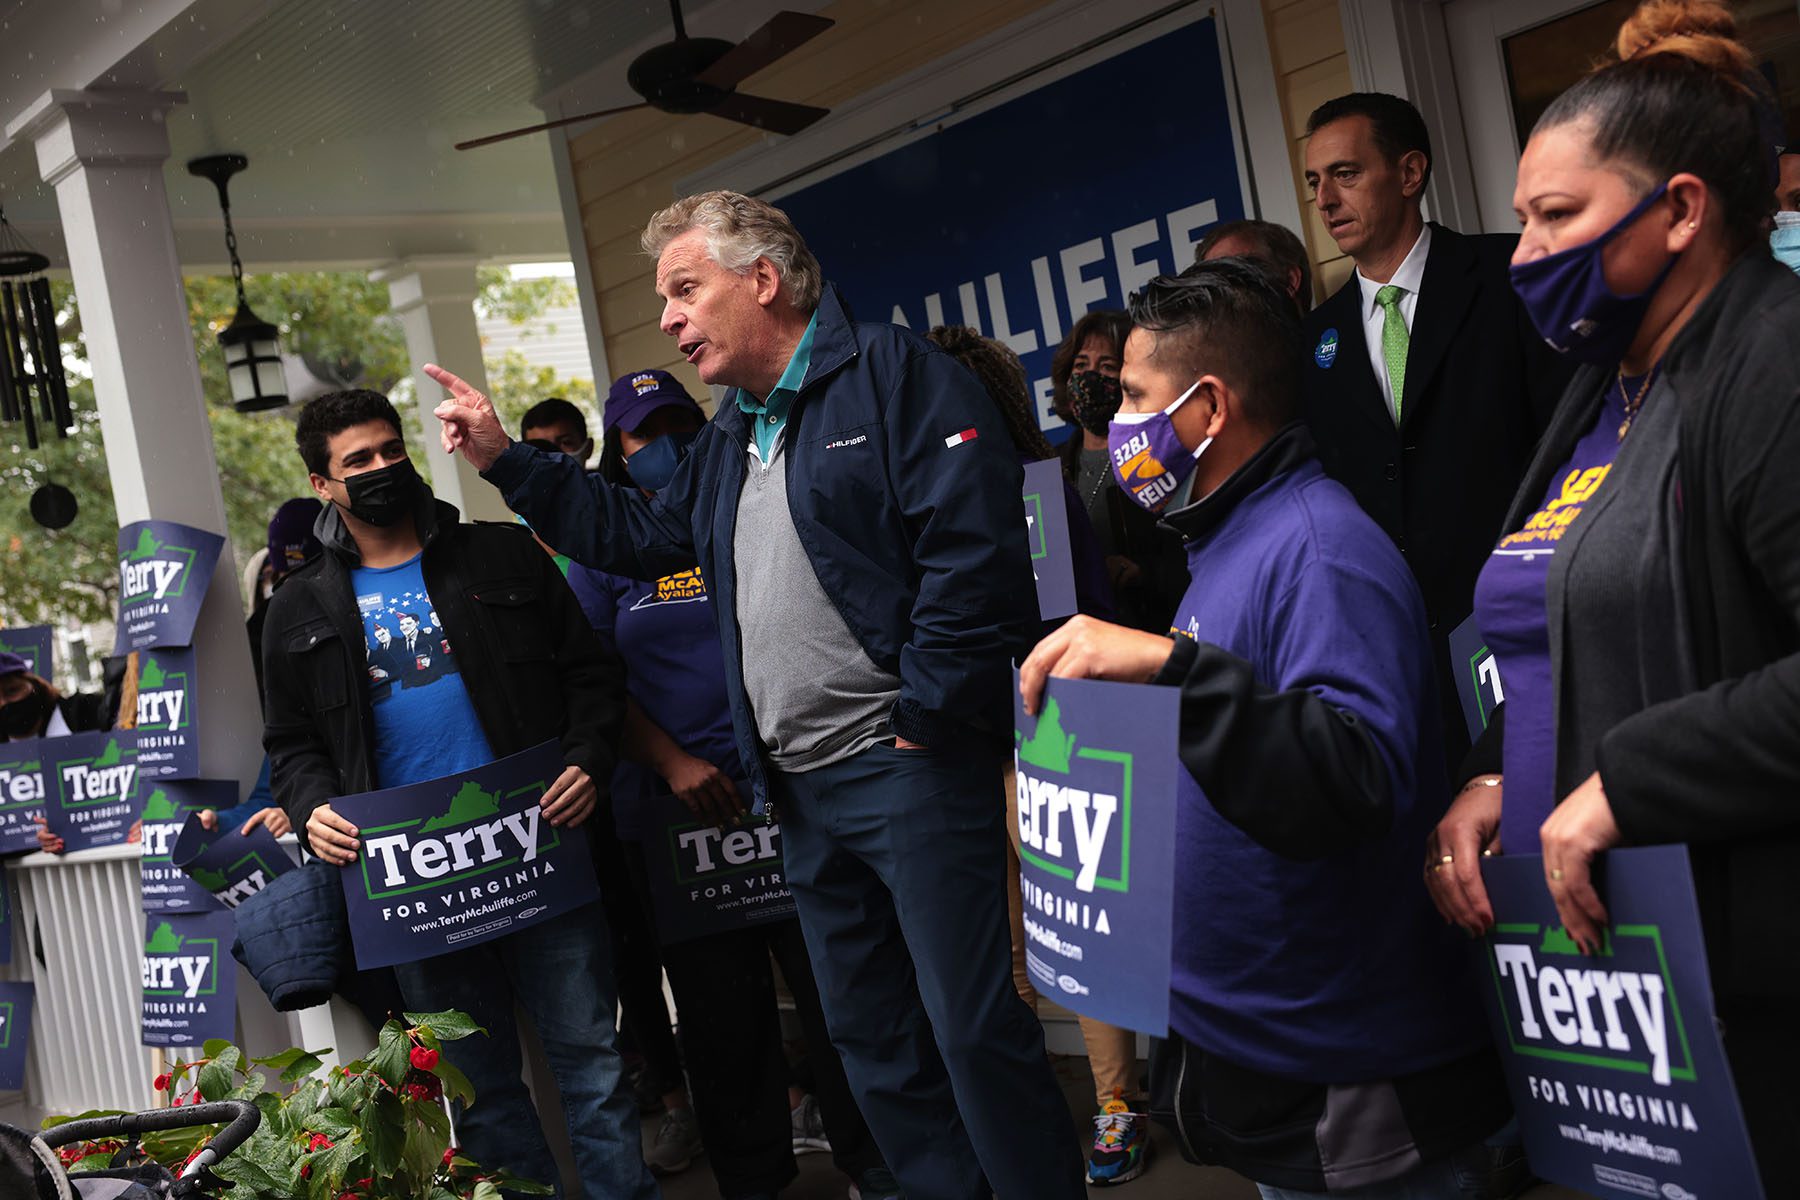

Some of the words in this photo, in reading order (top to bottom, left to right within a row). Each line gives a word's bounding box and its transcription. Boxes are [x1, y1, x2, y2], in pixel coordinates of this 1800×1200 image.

[891, 198, 1218, 355] ULIFF
[832, 434, 867, 448] HILFIGER
[1114, 430, 1150, 467] 32BJ
[1137, 471, 1178, 508] SEIU
[658, 577, 705, 592] McA
[137, 690, 184, 731] rry
[63, 764, 136, 801] Terry
[70, 811, 90, 824] FOR
[1015, 750, 1117, 893] erry
[141, 823, 184, 855] rr
[365, 804, 542, 888] Terry
[679, 824, 780, 872] Ter
[142, 868, 190, 881] IRGIN
[383, 901, 428, 921] FOR
[441, 861, 555, 909] VIRGINIA
[691, 884, 732, 901] FOR
[745, 874, 781, 888] VIR
[411, 889, 537, 933] www.TerryMcAuliffe.com
[1024, 878, 1110, 936] VIRGINIA
[1494, 944, 1671, 1086] Terry
[1528, 1076, 1570, 1106] FOR
[1576, 1084, 1698, 1132] VIRGINIA
